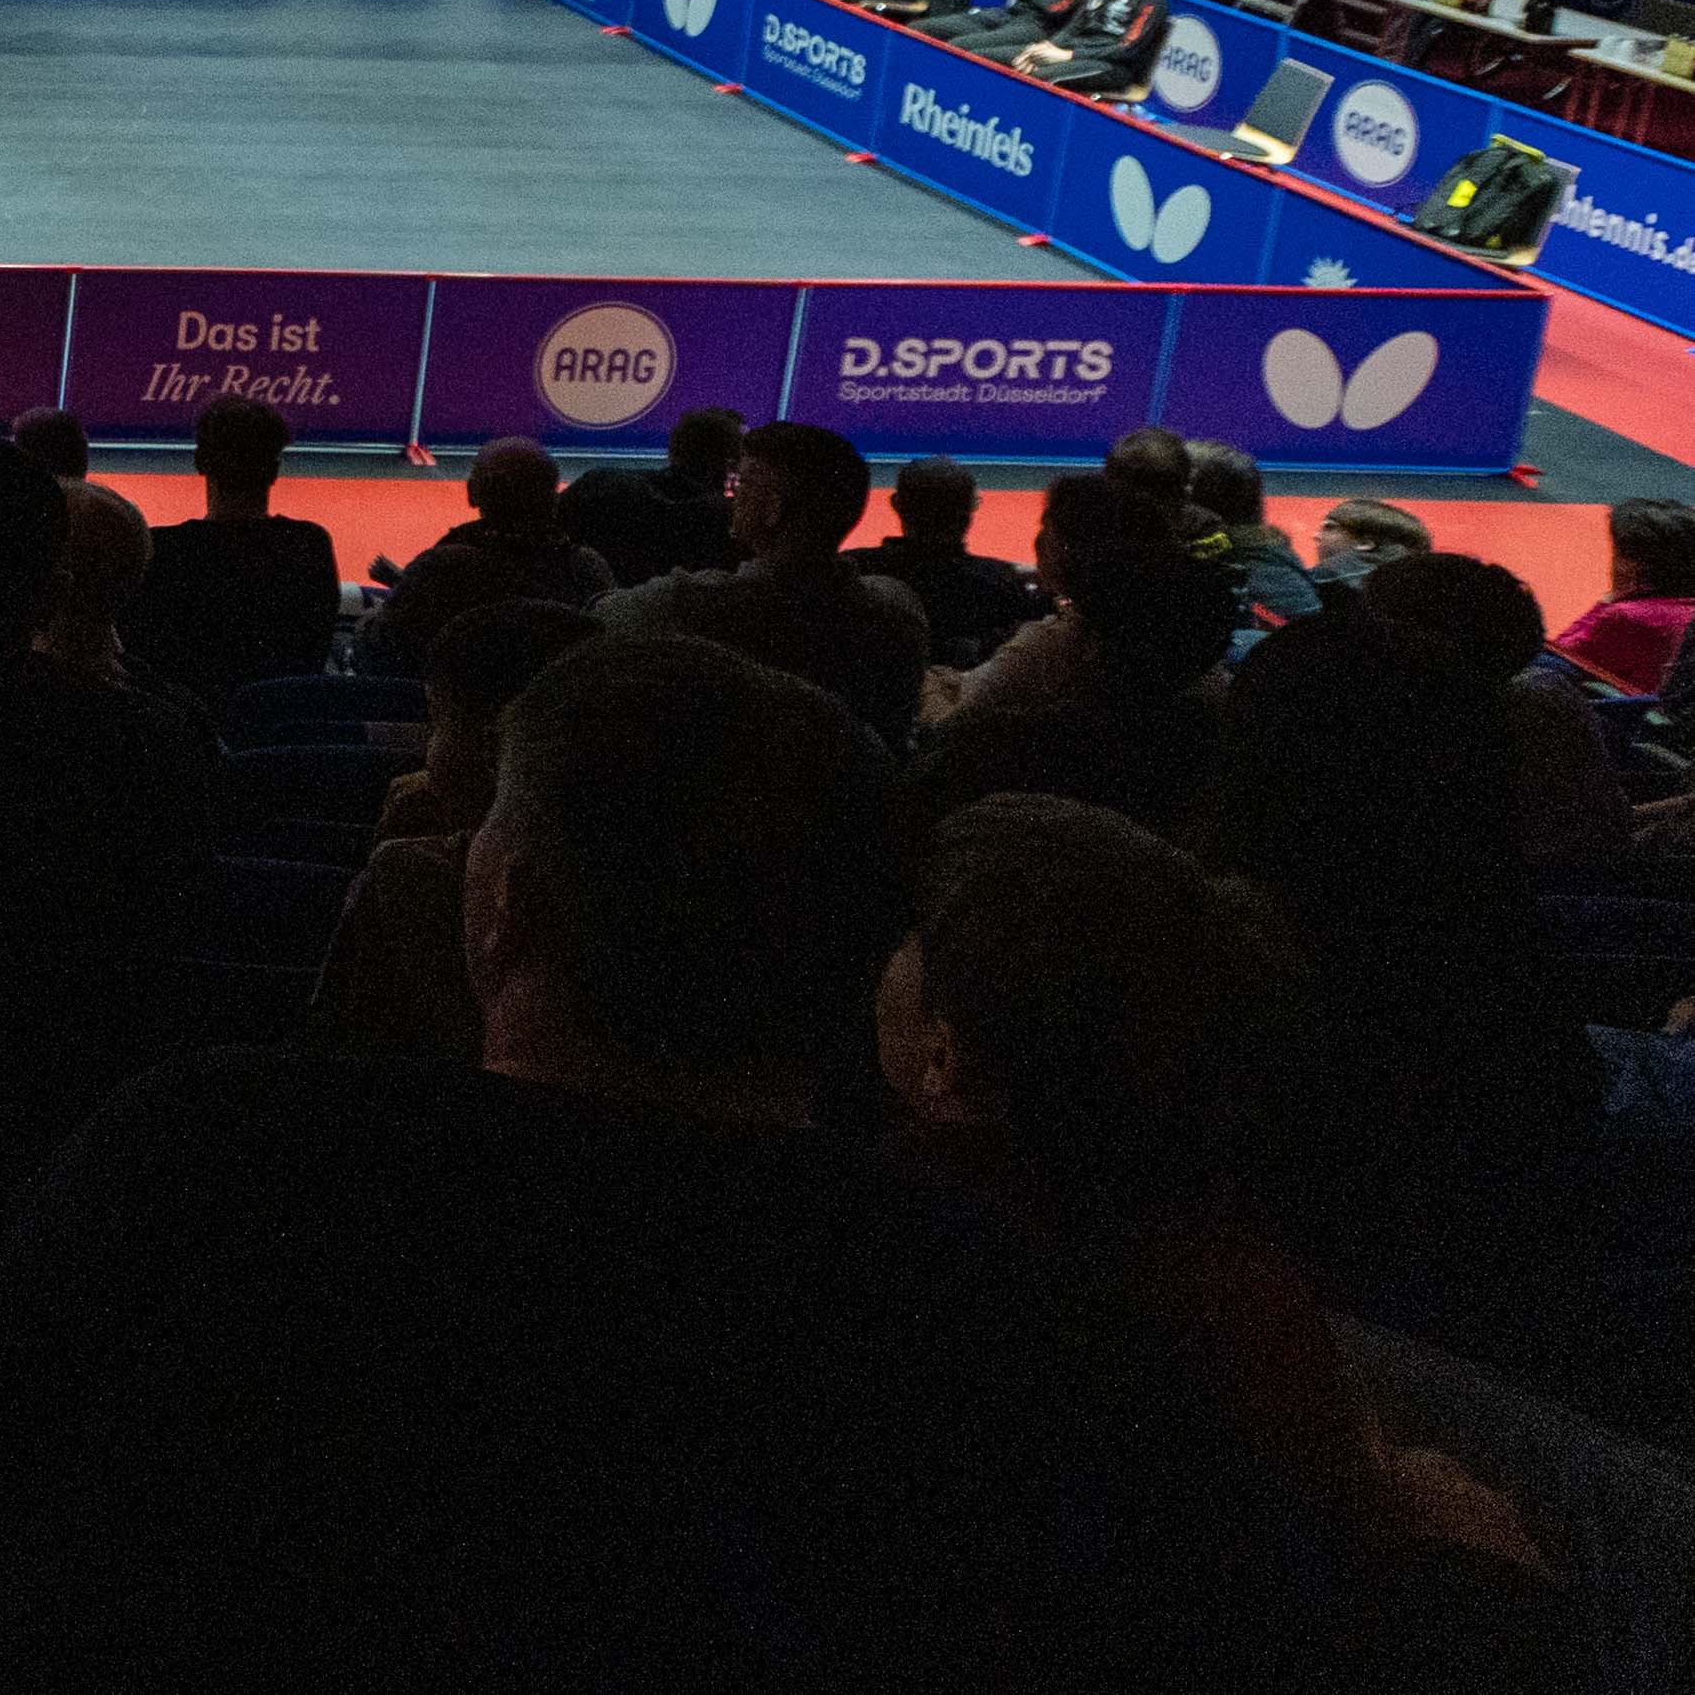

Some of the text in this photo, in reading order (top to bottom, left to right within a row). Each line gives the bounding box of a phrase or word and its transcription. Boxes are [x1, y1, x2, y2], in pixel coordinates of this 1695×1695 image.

[763, 12, 867, 87] D.SPORTS
[899, 81, 1035, 178] Rheinfels
[1345, 110, 1405, 157] ARAG
[175, 310, 321, 353] Das ist
[553, 346, 657, 385] ARAG
[840, 337, 1114, 381] D.SPORTS
[141, 362, 341, 406] Ihr Recht.
[839, 380, 1108, 404] Sportstadt Düsseldorf
